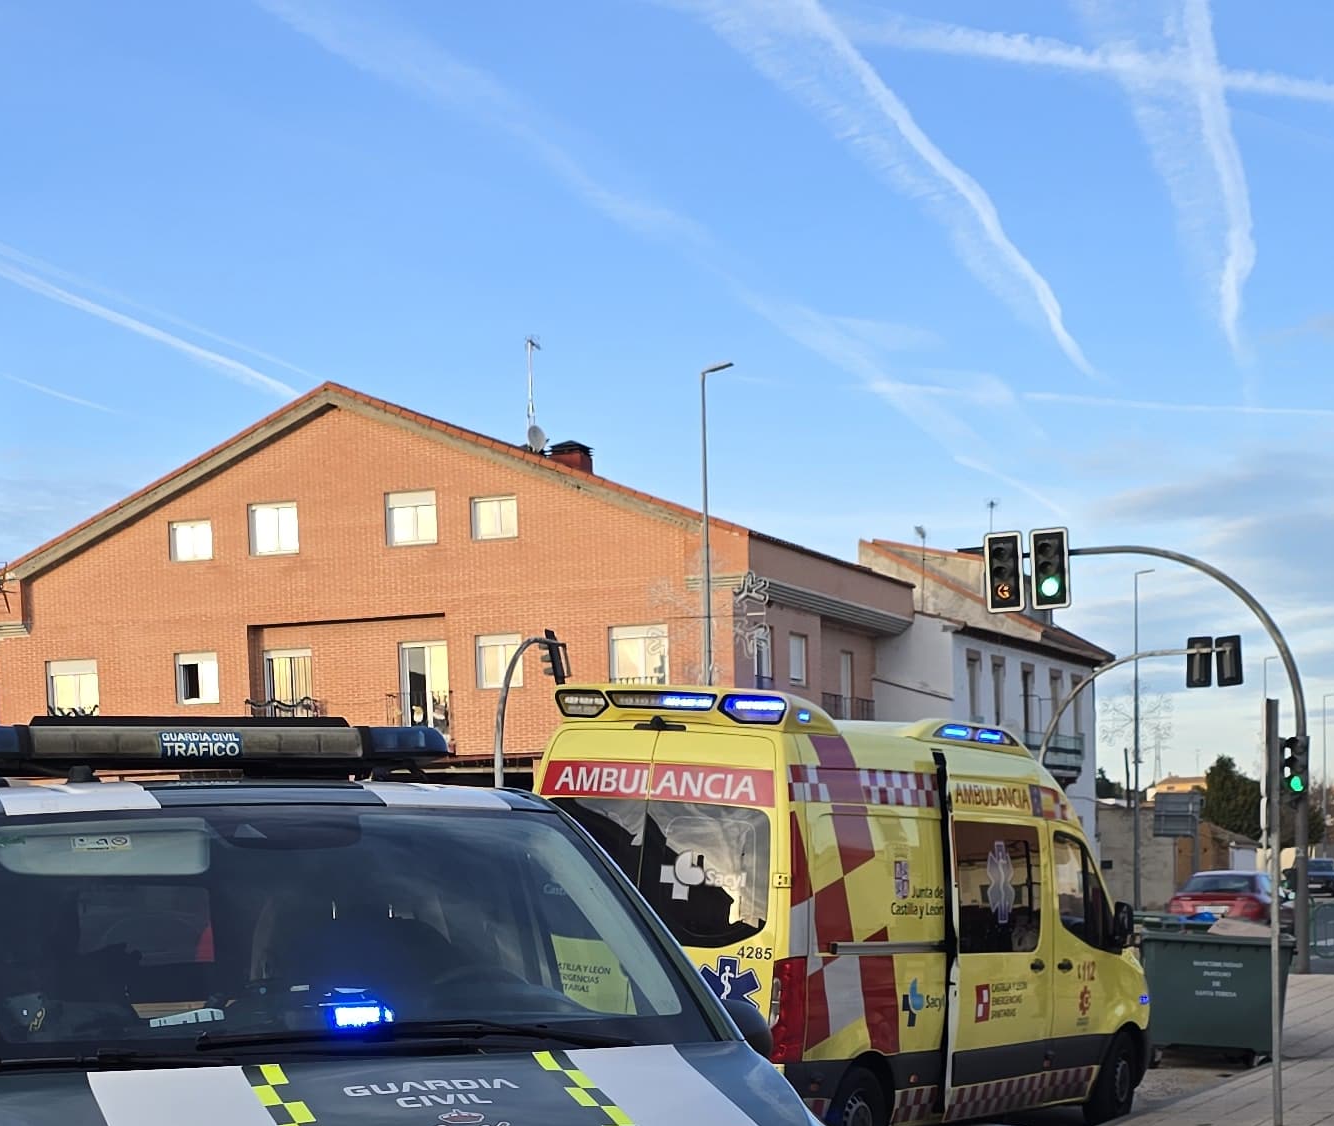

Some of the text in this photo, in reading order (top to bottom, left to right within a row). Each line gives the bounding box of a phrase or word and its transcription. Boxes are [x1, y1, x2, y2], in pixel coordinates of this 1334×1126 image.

[161, 732, 240, 742] GUARDIA CIVIL
[162, 742, 240, 757] TRAFICO
[554, 765, 757, 801] AMBULANCIA
[955, 782, 1031, 810] AMBULANCIA
[704, 868, 748, 891] Sacyl
[911, 884, 944, 899] Junta de
[890, 902, 918, 916] Castilla
[919, 905, 925, 920] y
[737, 946, 773, 960] 4285
[342, 1078, 520, 1097] GUARDIA
[395, 1092, 493, 1109] CIVIL
